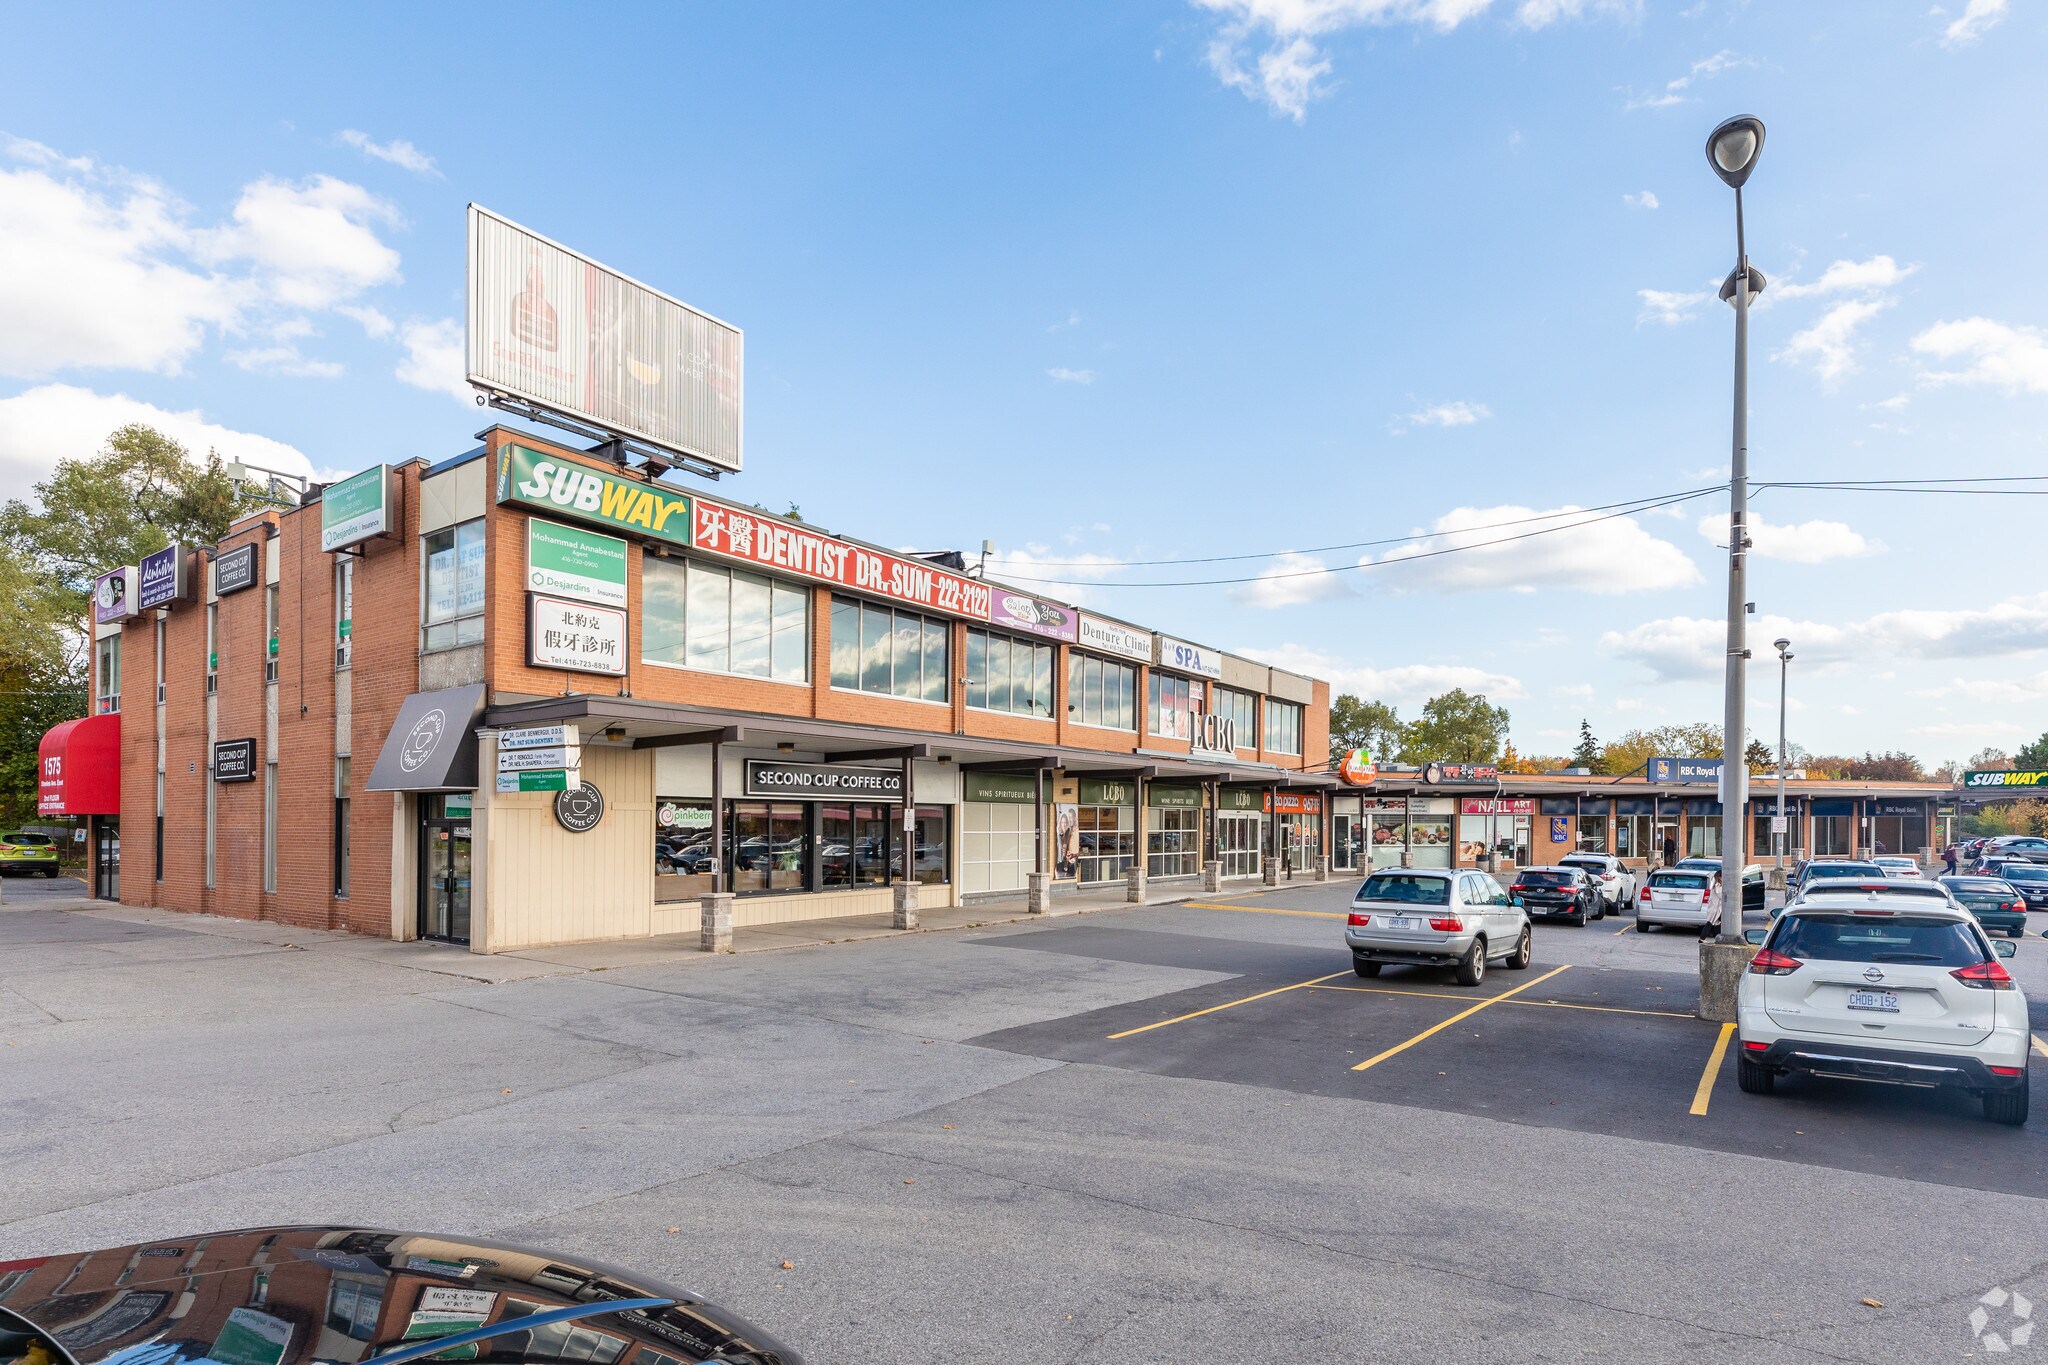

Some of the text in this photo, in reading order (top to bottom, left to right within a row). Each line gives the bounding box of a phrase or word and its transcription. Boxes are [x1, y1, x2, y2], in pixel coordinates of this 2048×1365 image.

[498, 446, 511, 501] SUBWAY
[519, 461, 686, 532] SUBWAY
[333, 519, 380, 542] Desjardins Insurance
[697, 507, 756, 556] 牙醫
[532, 531, 625, 560] Mohammad Annabestani
[572, 549, 588, 559] Agent
[143, 557, 175, 582] dentistry
[220, 556, 248, 573] SECOND CUP
[561, 556, 599, 569] 416-730-0900
[757, 519, 850, 581] DENTIST
[890, 562, 933, 603] SUM
[938, 576, 988, 617] 222-2122
[222, 571, 238, 584] COFFEE
[442, 562, 480, 585] DETIST
[547, 576, 624, 600] Desjardins Insurance
[1007, 598, 1032, 616] Salon
[1041, 605, 1061, 621] You
[561, 611, 600, 630] 北約克
[1034, 625, 1043, 633] 416
[1048, 628, 1059, 637] 222
[1083, 622, 1121, 645] Denture
[1125, 635, 1150, 653] Clinic
[544, 629, 616, 657] 假牙診所
[1175, 645, 1202, 671] SPA
[413, 714, 438, 736] SECOND
[1190, 711, 1236, 754] LCBO
[218, 749, 246, 760] SECOND CUP
[44, 756, 61, 775] 1575
[220, 761, 236, 771] COFFEE
[1680, 766, 1715, 779] RBC Royal
[759, 771, 812, 786] SECOND
[815, 774, 838, 787] CUP
[841, 776, 882, 789] COFFEE
[1967, 772, 2048, 787] SUBWAY
[587, 790, 598, 803] CUP
[979, 790, 993, 798] VINS
[995, 791, 1025, 799] SPIRITUEUX
[1103, 784, 1125, 802] LCBO
[1235, 793, 1251, 807] LCBO
[1283, 796, 1299, 811] pizza
[1478, 800, 1511, 813] NAIL
[1514, 800, 1531, 809] ART
[564, 812, 586, 827] COFFEE
[674, 810, 711, 822] pinkberr
[1849, 993, 1898, 1008] CHDB 152
